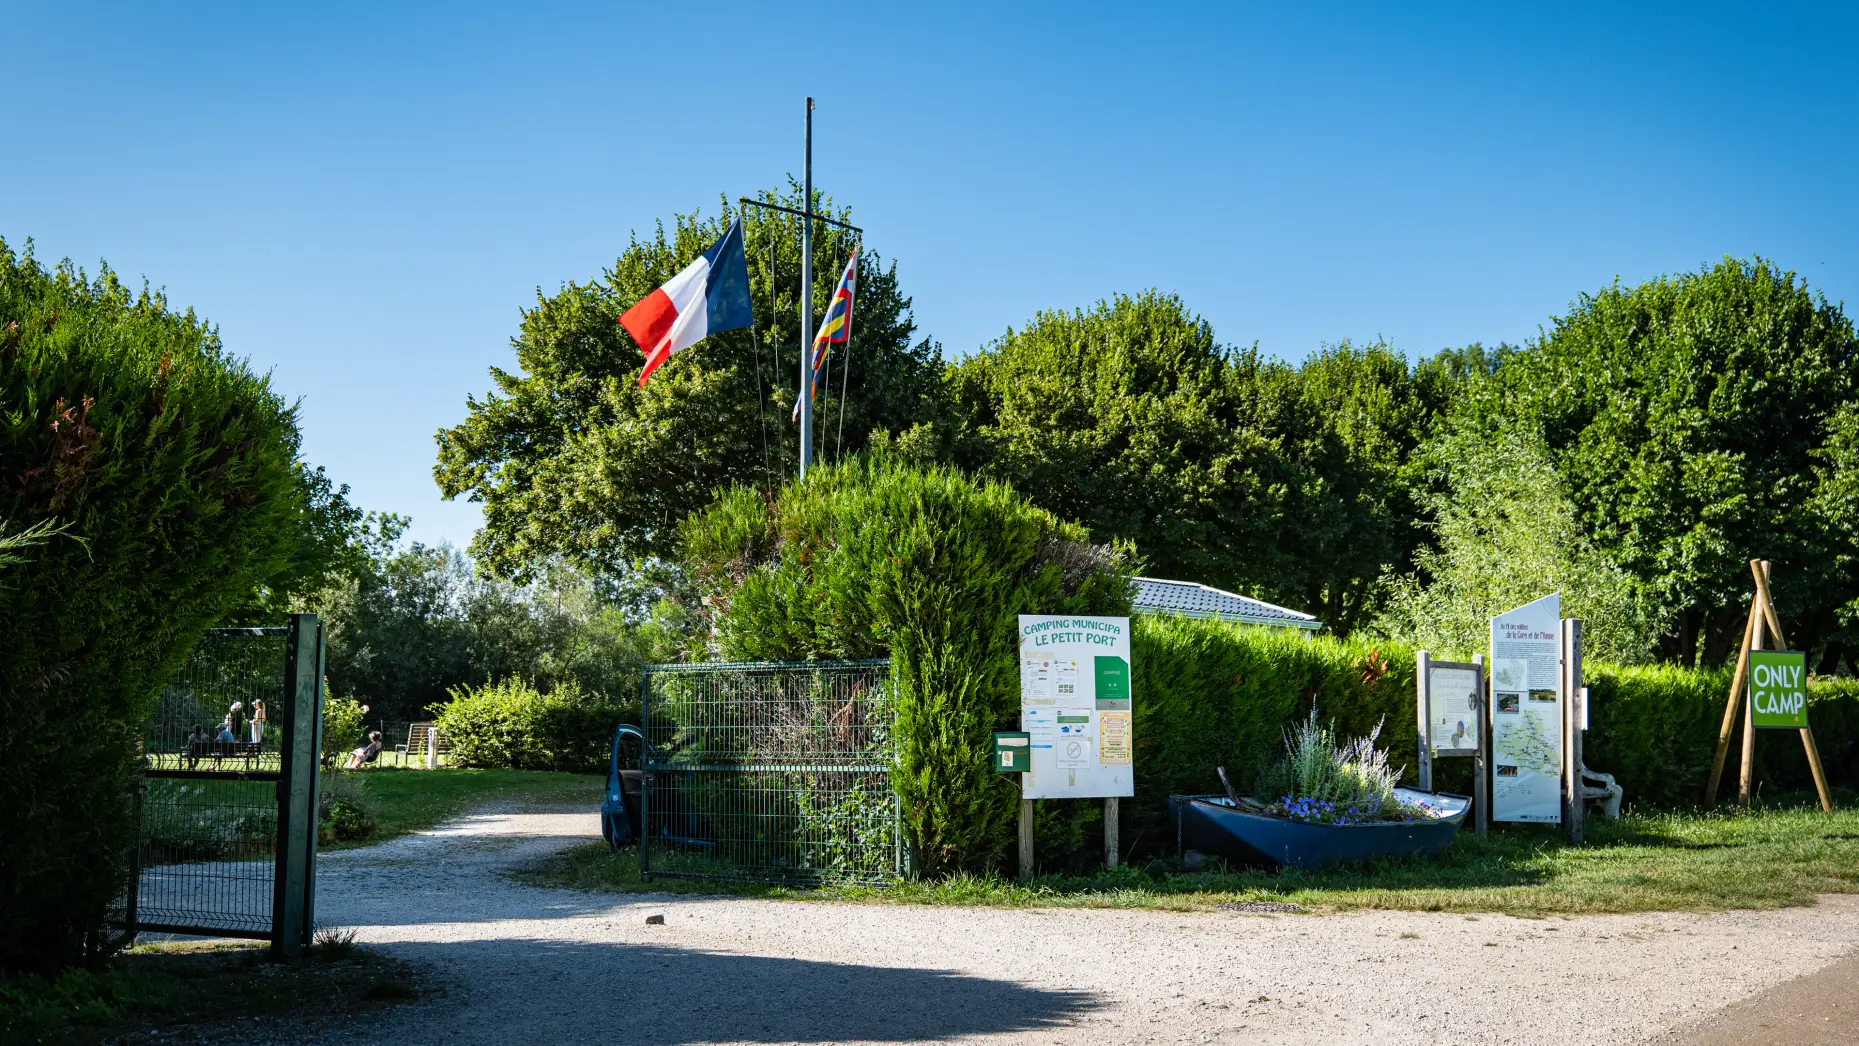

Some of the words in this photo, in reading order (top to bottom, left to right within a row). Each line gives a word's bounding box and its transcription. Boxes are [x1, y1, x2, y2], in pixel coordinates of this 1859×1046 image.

[1024, 620, 1069, 635] CAMPING
[1072, 620, 1120, 635] MUNICIPA
[1513, 631, 1517, 639] la
[1035, 635, 1049, 647] LE
[1051, 632, 1083, 644] PETIT
[1086, 633, 1117, 647] PORT
[1754, 664, 1801, 688] ONLY
[1754, 690, 1804, 714] CAMP
